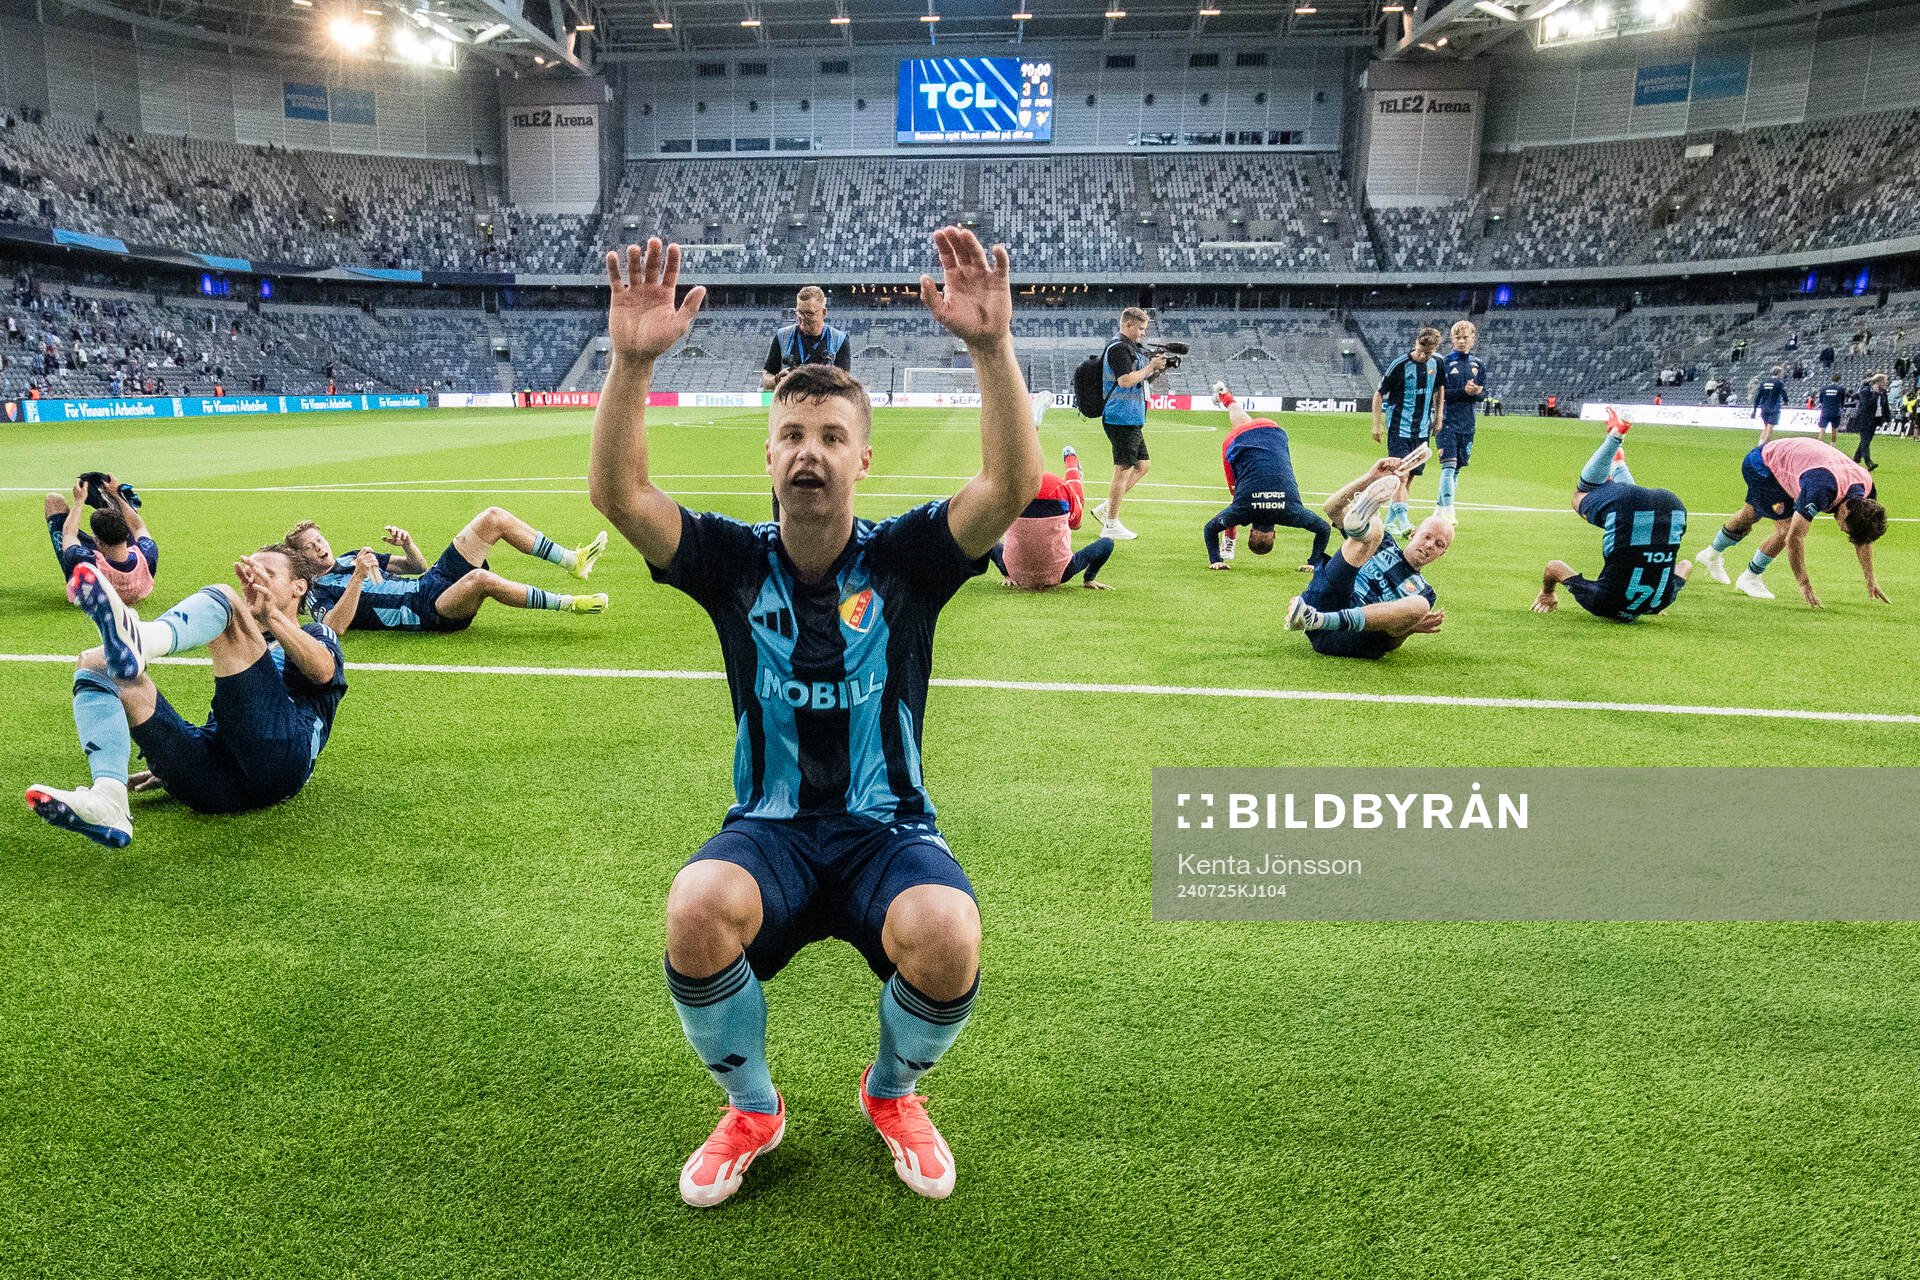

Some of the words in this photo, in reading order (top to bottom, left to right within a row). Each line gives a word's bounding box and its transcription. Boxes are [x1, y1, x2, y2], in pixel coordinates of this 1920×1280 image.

[919, 82, 997, 109] TCL
[1022, 82, 1031, 96] 3
[1039, 82, 1048, 96] 0
[1379, 95, 1424, 113] TELE2
[1427, 100, 1471, 113] Arena
[512, 110, 552, 127] TELE2
[555, 114, 594, 127] Arena
[1296, 398, 1358, 412] stadium
[1251, 501, 1286, 510] MOBILL
[1642, 551, 1673, 563] TCL
[1625, 567, 1671, 610] 14
[760, 667, 883, 710] MOBILL
